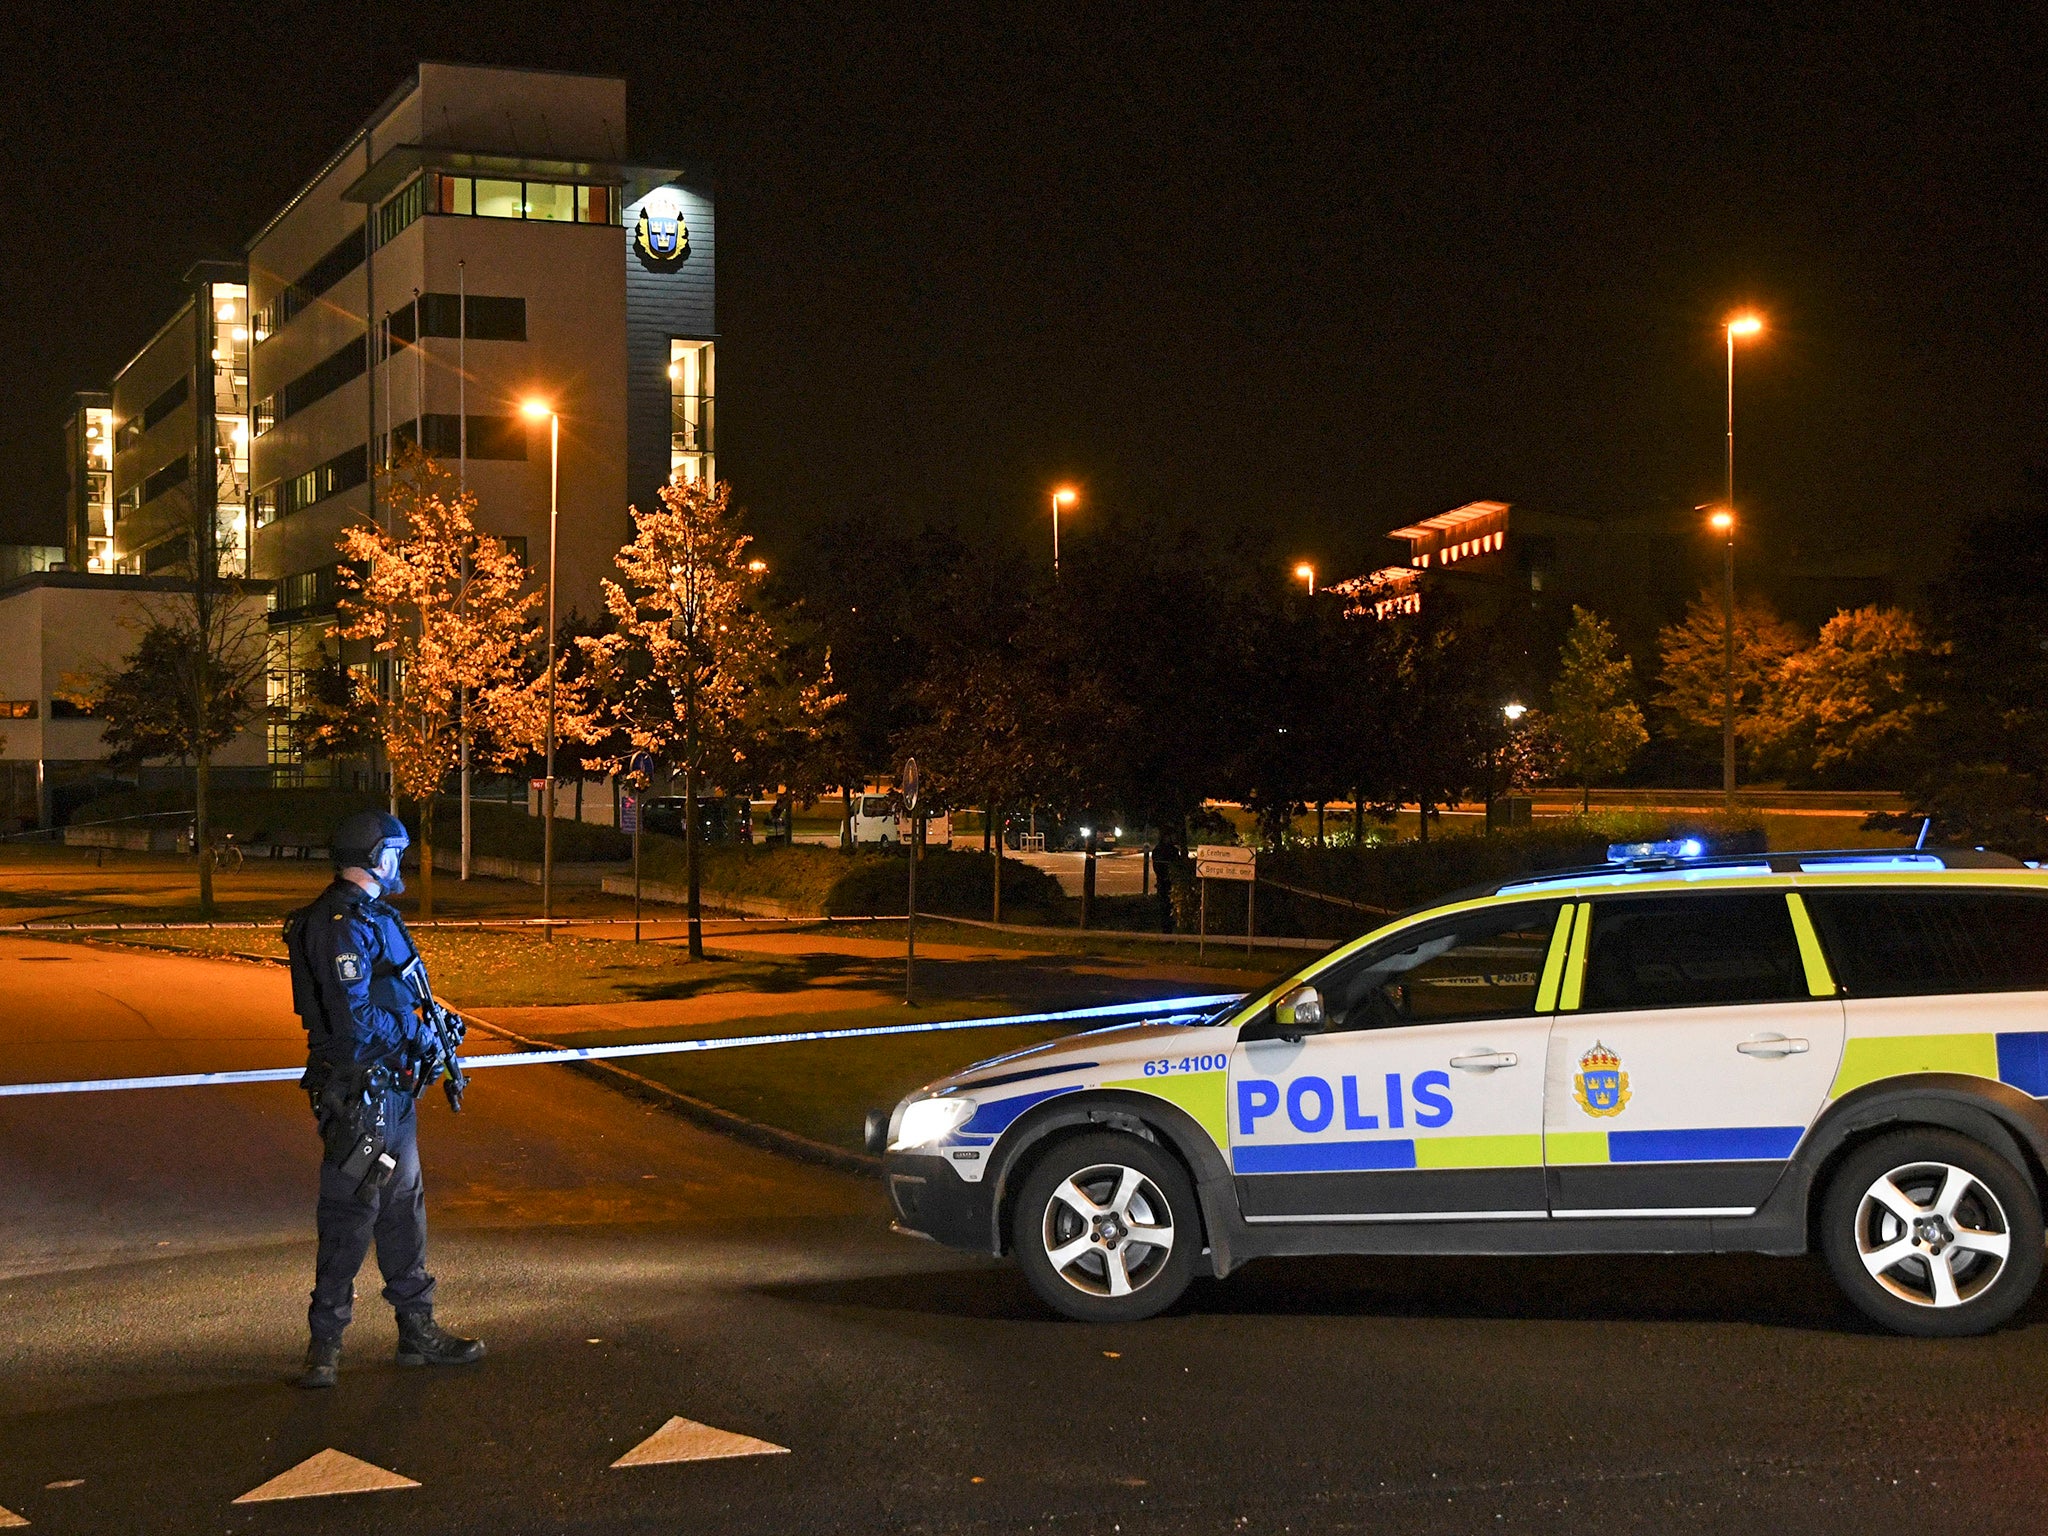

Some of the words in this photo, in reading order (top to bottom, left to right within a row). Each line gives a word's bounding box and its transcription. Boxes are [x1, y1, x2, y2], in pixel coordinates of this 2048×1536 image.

[1206, 849, 1231, 857] Centrum
[337, 954, 357, 963] POLIS
[1497, 973, 1527, 983] POLIS
[1143, 1054, 1227, 1076] 63-4100
[1237, 1071, 1454, 1135] POLIS
